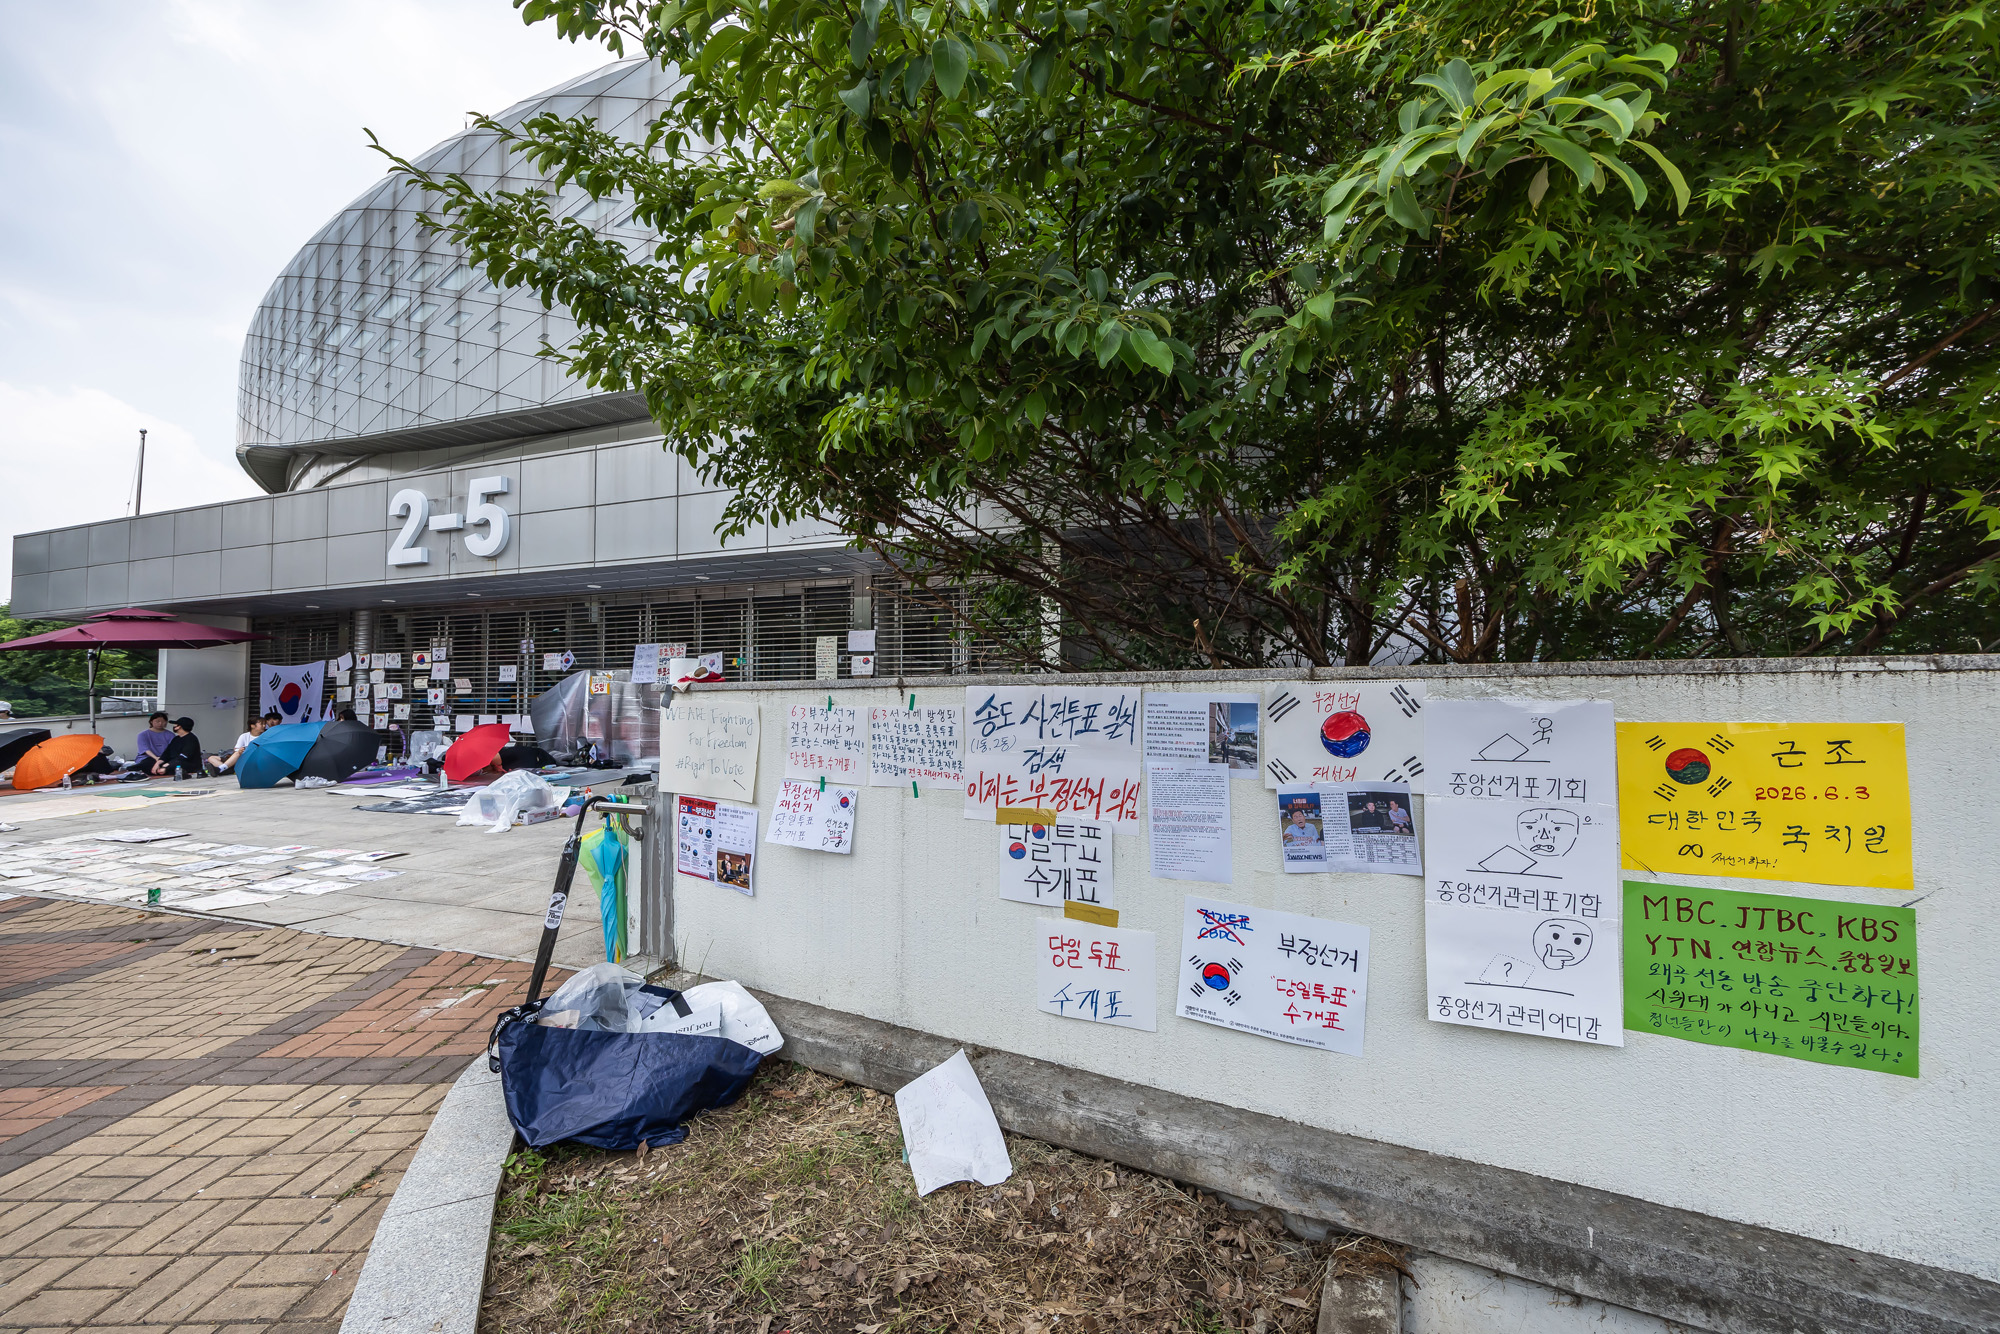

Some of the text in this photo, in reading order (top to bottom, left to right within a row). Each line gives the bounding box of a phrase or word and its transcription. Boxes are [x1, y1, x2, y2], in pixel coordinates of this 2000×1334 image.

[387, 475, 510, 566] 2-5
[810, 706, 855, 722] 부정선거
[1312, 691, 1361, 714] 부정선거
[710, 708, 754, 736] Fighting
[872, 708, 956, 724] 6.3 선거에 발생된
[872, 722, 892, 732] 타인
[973, 693, 1016, 738] 송도
[1020, 694, 1103, 740] 사전투표
[1102, 694, 1138, 746] 일치
[689, 725, 746, 750] For Freedom
[790, 722, 854, 738] 전국 재선거
[707, 758, 720, 774] To
[722, 759, 744, 776] Vote
[1022, 746, 1066, 774] 검색
[1312, 766, 1357, 782] 재선거
[782, 782, 820, 801] 부정선거
[967, 770, 1018, 809] 이제는
[1018, 772, 1104, 820] 부정선거
[1105, 778, 1140, 822] 의심
[778, 800, 812, 814] 재선거
[775, 812, 814, 827] 당일투표
[1648, 810, 1762, 834] 대한민국
[774, 827, 806, 842] 수개표
[1782, 824, 1888, 854] 국치일
[1024, 865, 1100, 904] 수개표
[1200, 908, 1254, 932] 전자투표
[1838, 915, 1900, 942] KBS
[1200, 927, 1236, 942] CBDC
[1048, 934, 1083, 969] 당일
[1278, 932, 1358, 972] 부정선거
[1648, 962, 1690, 986] 왜곡
[1694, 970, 1734, 992] 선동
[1743, 972, 1791, 997] 방송
[1049, 982, 1132, 1022] 수개표
[1740, 1000, 1800, 1022] 아니고
[1283, 1002, 1345, 1032] 수개표
[744, 1034, 770, 1046] Disney
[1744, 1026, 1795, 1049] 나라를
